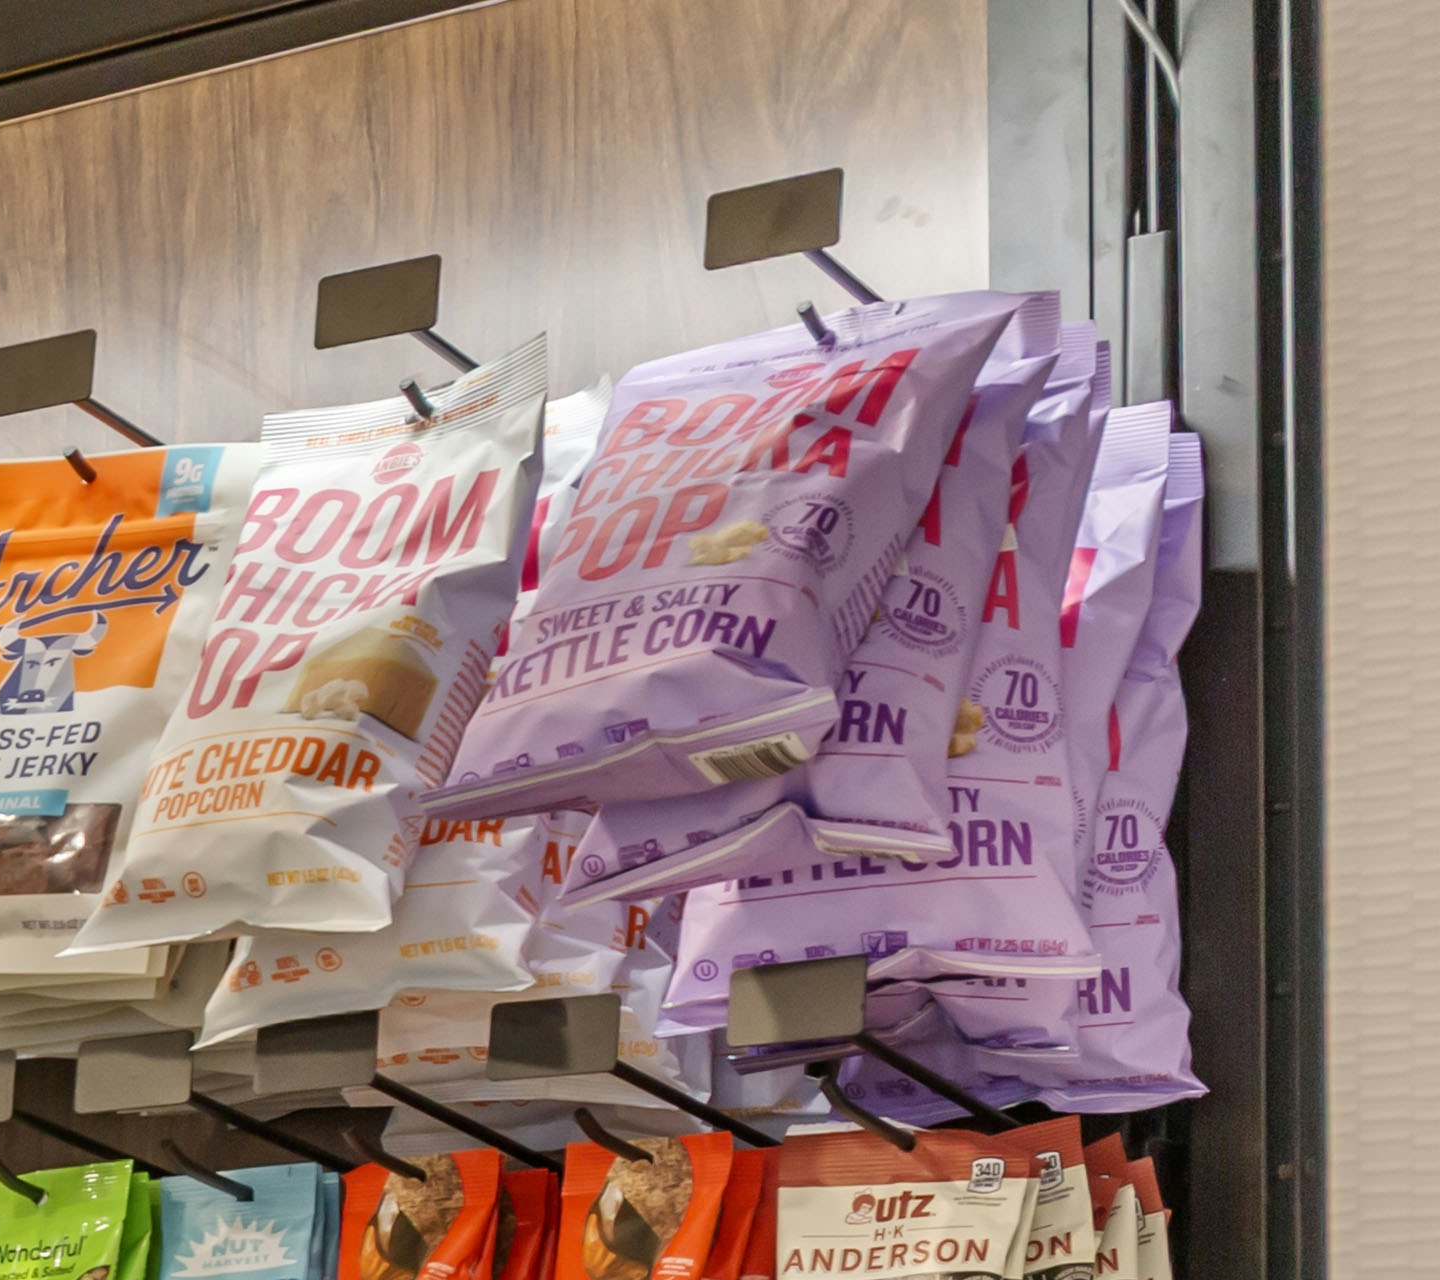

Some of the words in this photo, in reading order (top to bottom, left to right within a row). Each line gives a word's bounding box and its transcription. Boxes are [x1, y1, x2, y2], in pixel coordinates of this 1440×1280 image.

[238, 471, 501, 570] BOOM
[537, 600, 621, 644] SWEET
[624, 592, 644, 618] &
[652, 584, 740, 609] SALTY
[492, 624, 642, 702] KETTLE
[643, 609, 777, 659] CORN
[1003, 670, 1039, 708] 70
[5, 752, 98, 780] JERKY
[196, 735, 381, 793] CHEDDAR
[153, 780, 266, 823] POPCORN
[1105, 814, 1138, 851] 70
[973, 1160, 1003, 1180] 340
[212, 1236, 265, 1258] NUT
[783, 1238, 989, 1274] ANDERSON
